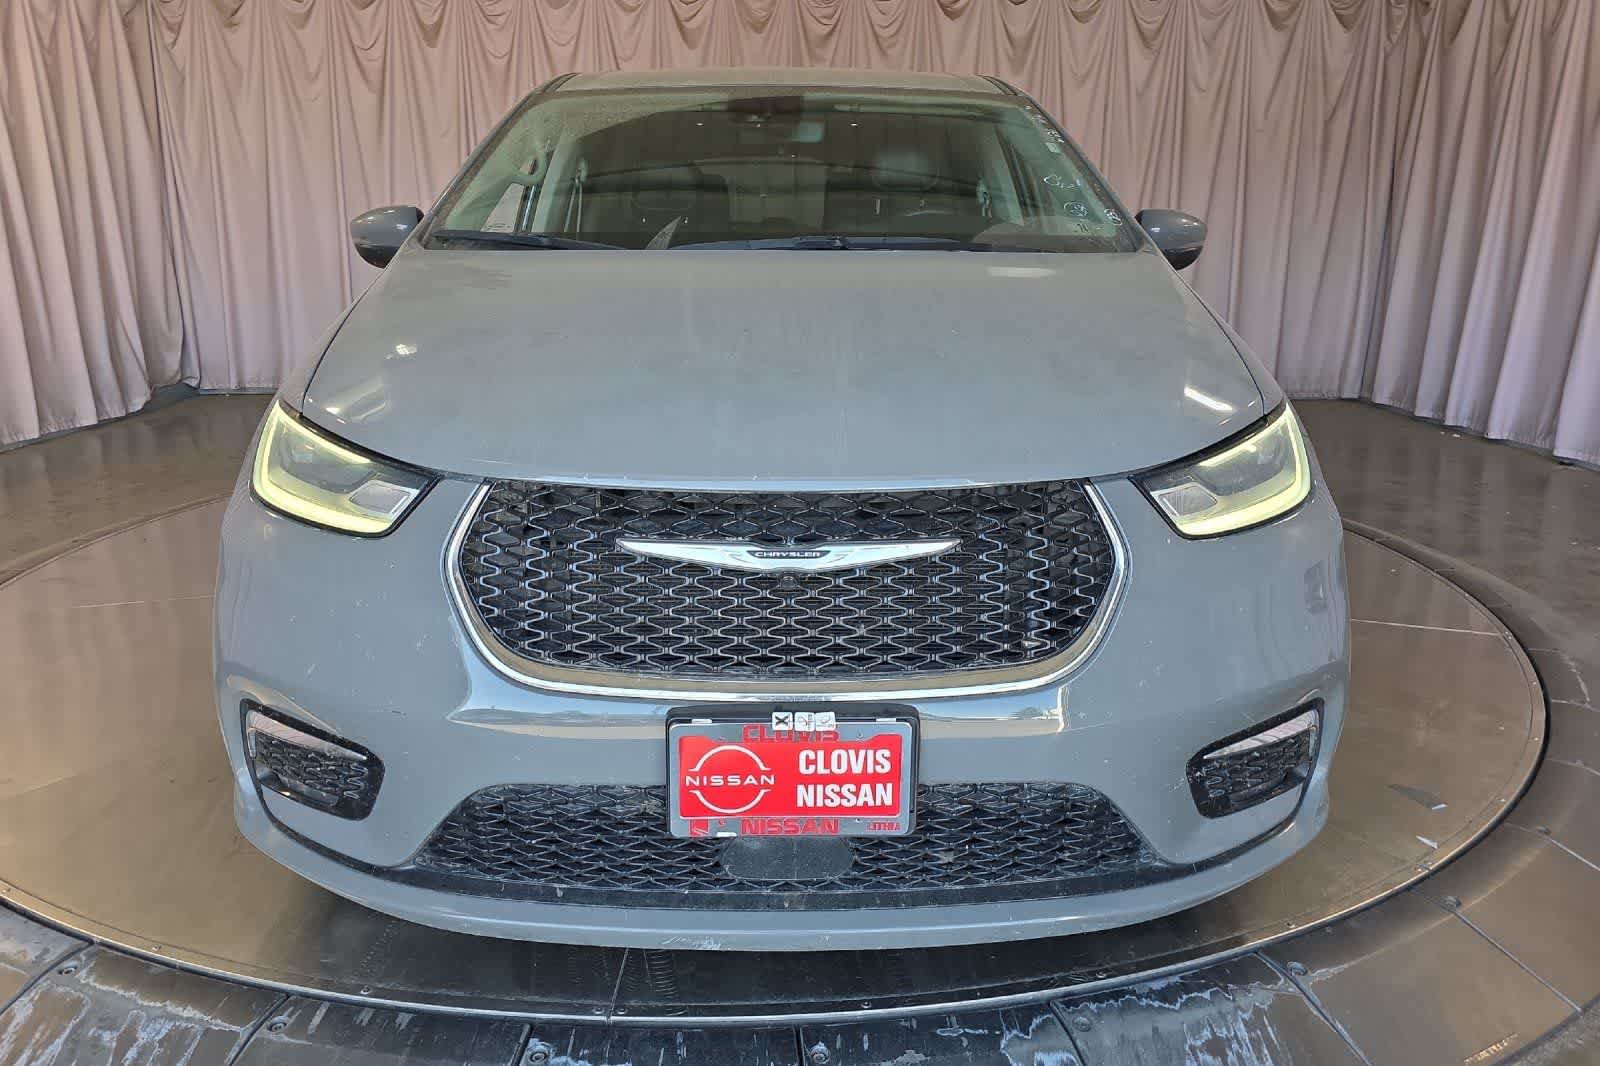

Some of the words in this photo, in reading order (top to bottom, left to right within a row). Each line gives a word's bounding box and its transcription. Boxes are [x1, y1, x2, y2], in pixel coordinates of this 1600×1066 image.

[799, 749, 891, 774] CLOVIS
[685, 774, 776, 786] NISSAN
[797, 783, 893, 808] NISSAN
[741, 818, 839, 835] NISSAN
